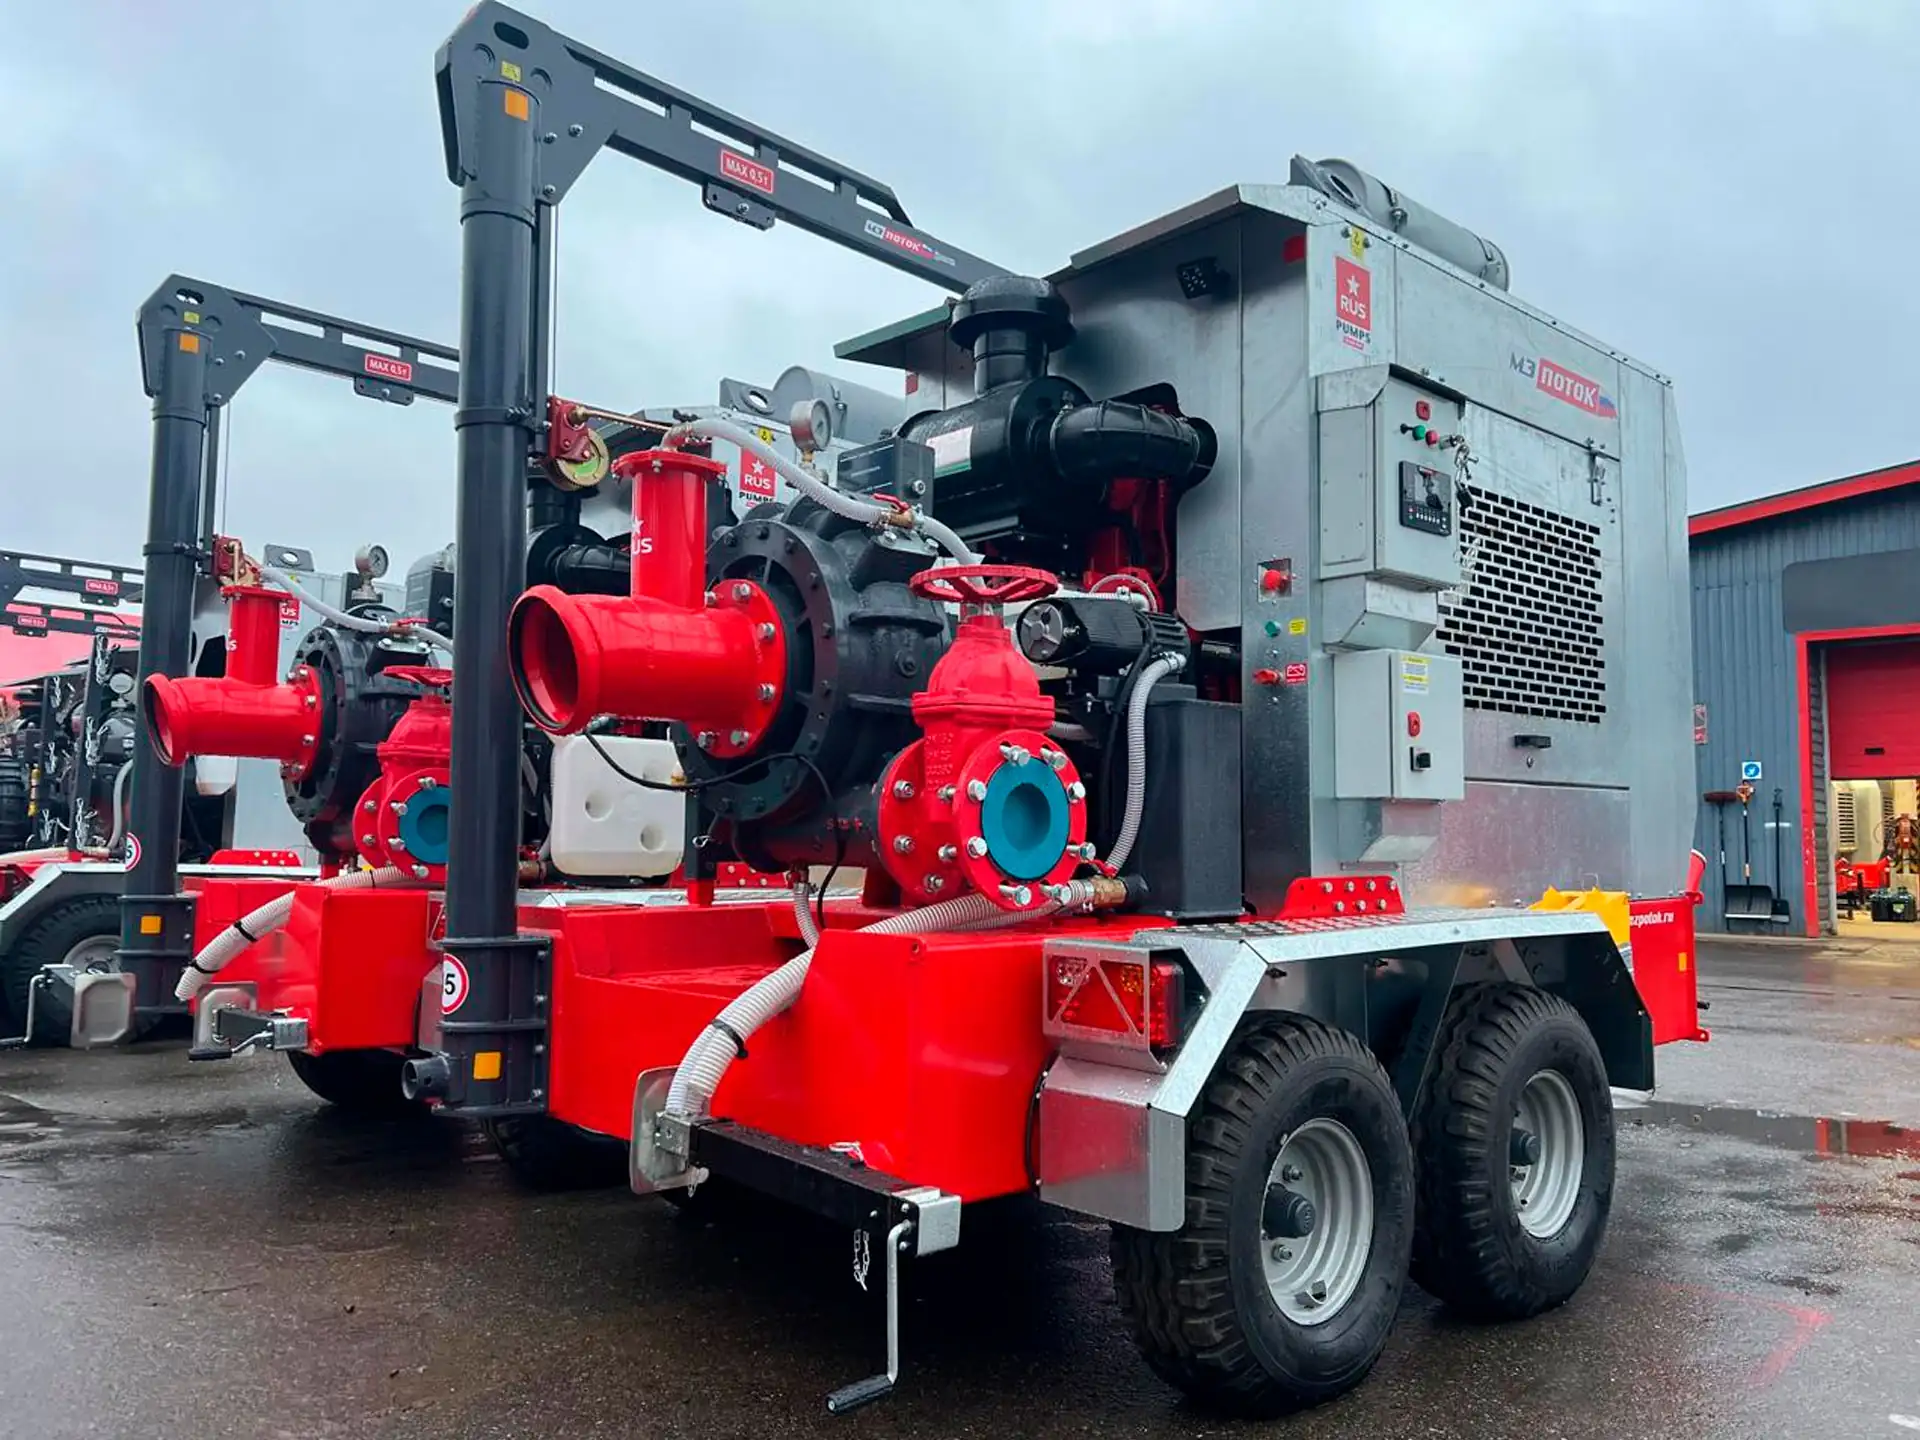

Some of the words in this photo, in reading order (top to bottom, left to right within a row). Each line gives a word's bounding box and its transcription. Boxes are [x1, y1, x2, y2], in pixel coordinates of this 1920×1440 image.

[725, 157, 748, 178] MAX
[885, 230, 921, 252] ПОТОК
[1340, 294, 1367, 320] RUS
[1335, 319, 1372, 344] PUMPS
[369, 359, 389, 372] MAX
[1509, 352, 1536, 379] МЗ
[1540, 366, 1597, 408] ПОТОК
[744, 473, 772, 490] RUS
[444, 973, 456, 995] 5
